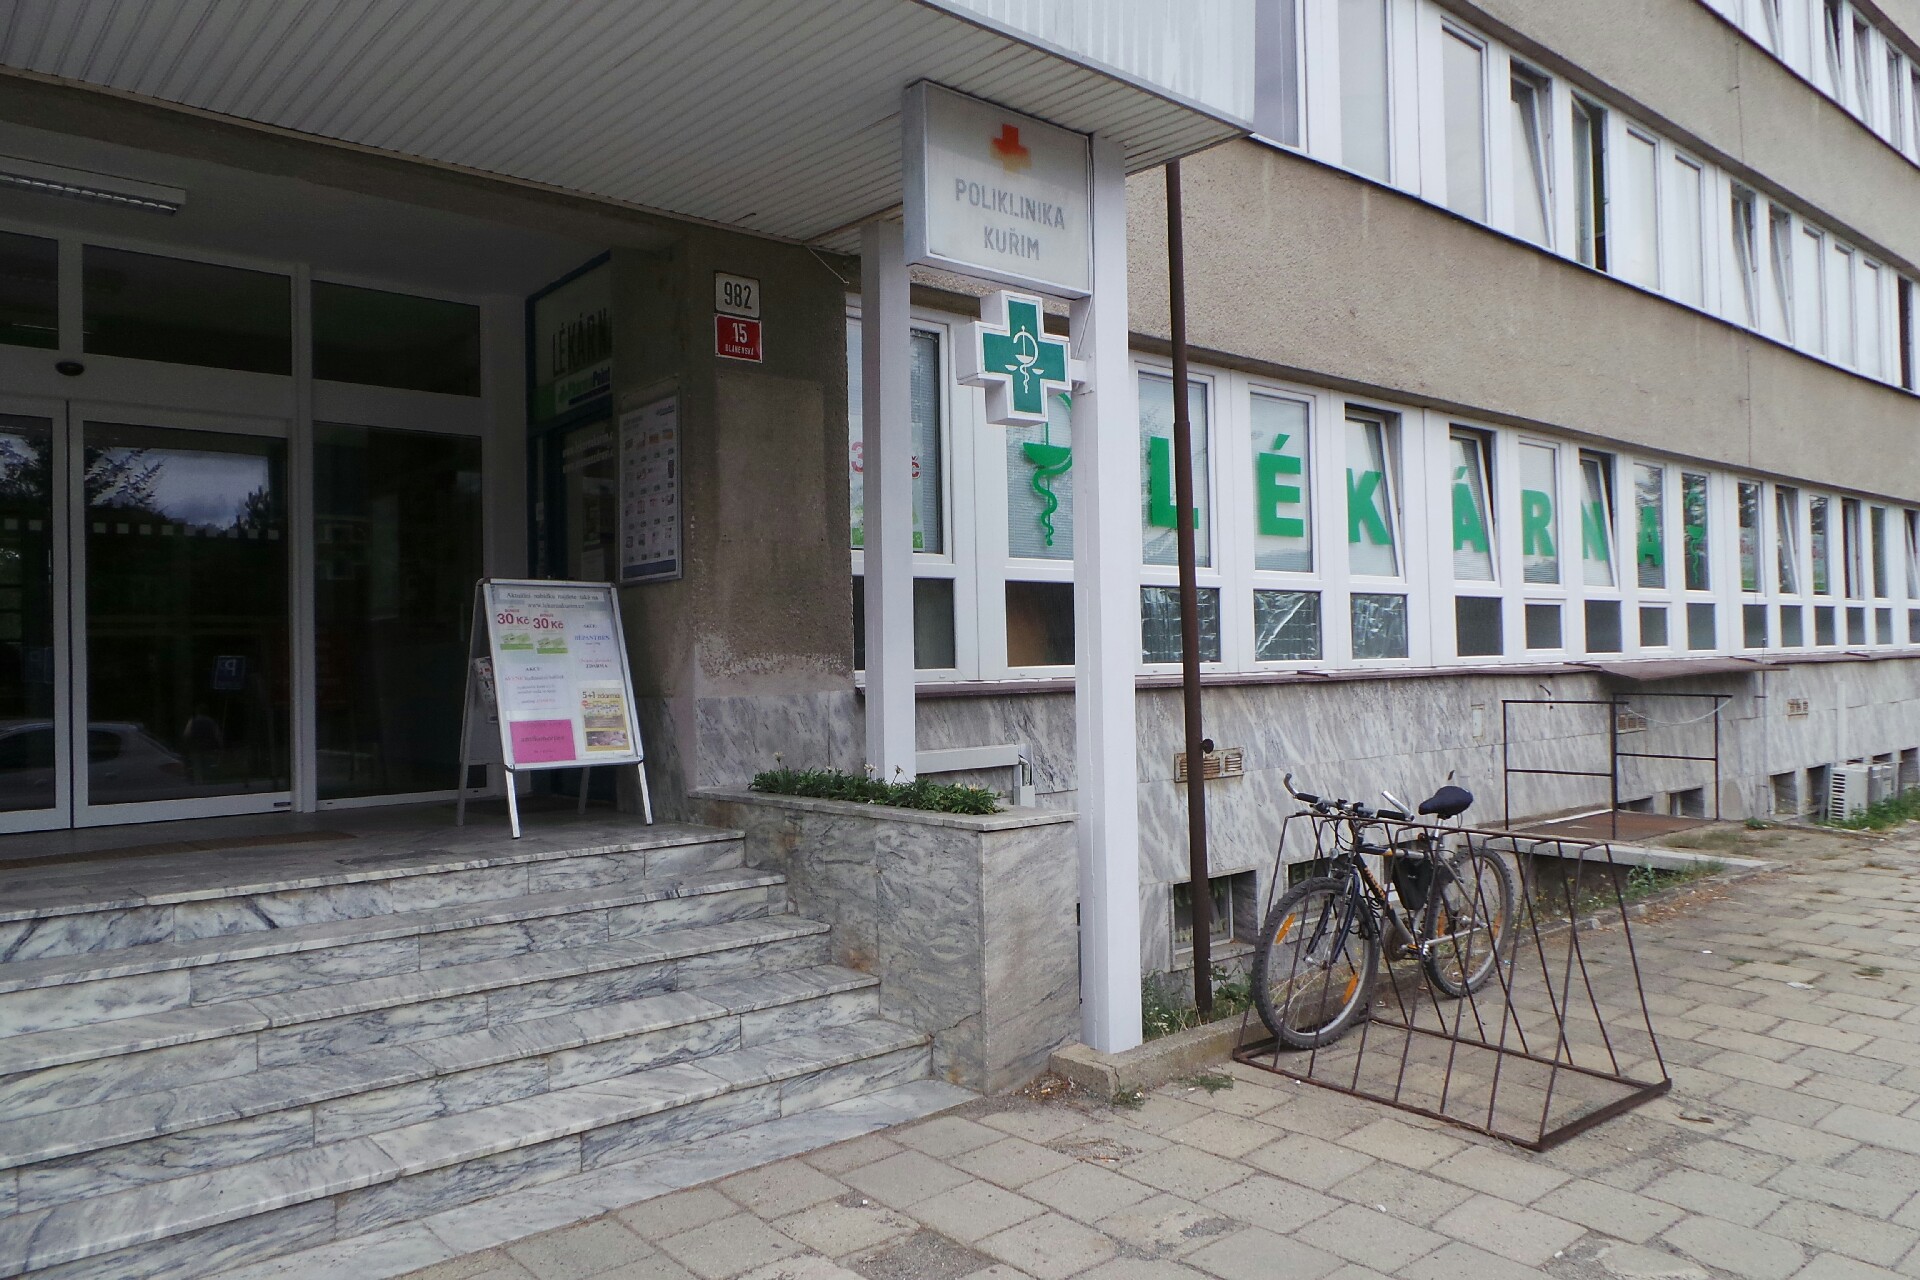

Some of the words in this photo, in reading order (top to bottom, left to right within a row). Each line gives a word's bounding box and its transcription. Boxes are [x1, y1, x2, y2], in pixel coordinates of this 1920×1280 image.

[954, 177, 1065, 230] POLIKLINIKA
[983, 225, 1041, 261] KUŘIM
[724, 281, 752, 310] 982
[732, 322, 748, 344] 15
[497, 613, 514, 625] 30
[516, 615, 530, 625] Kč
[532, 617, 549, 629] 30
[551, 619, 564, 629] Kč
[582, 691, 596, 699] 5+1
